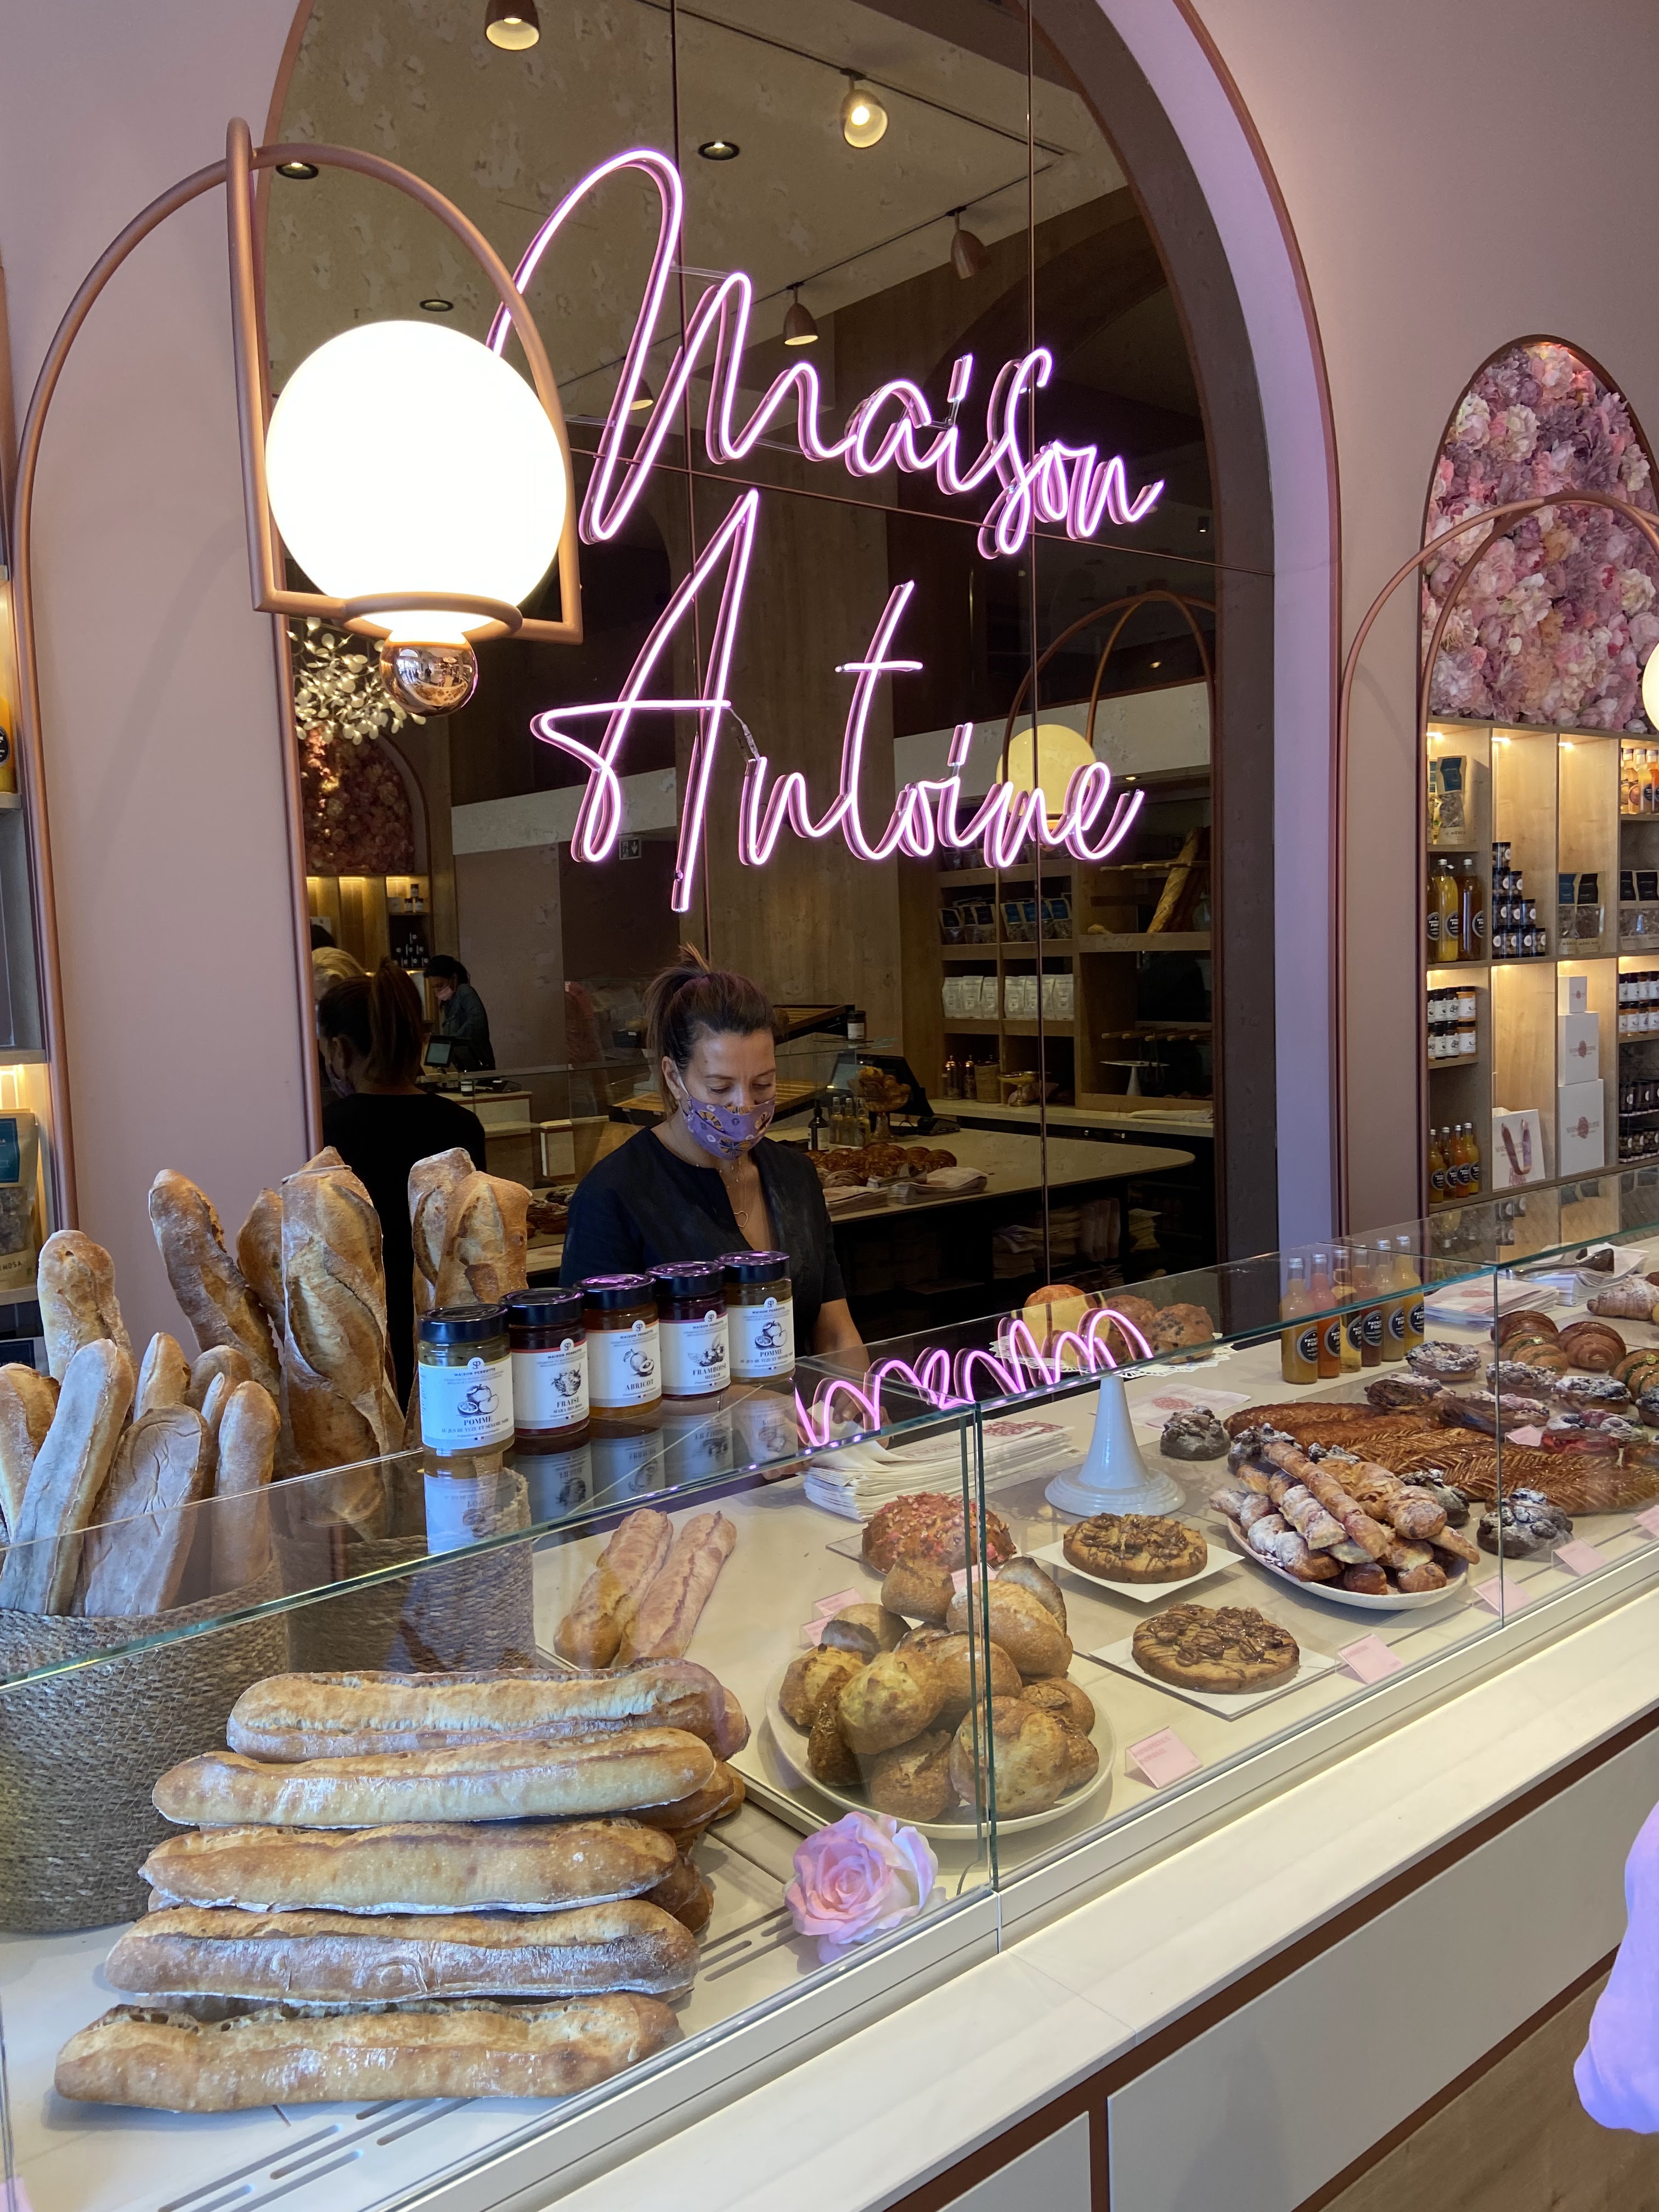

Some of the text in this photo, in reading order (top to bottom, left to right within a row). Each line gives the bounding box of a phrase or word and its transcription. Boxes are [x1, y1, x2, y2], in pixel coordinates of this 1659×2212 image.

[487, 148, 1164, 558] Maison
[531, 488, 1145, 912] Antoine
[0, 1261, 22, 1271] MOSA
[760, 1349, 782, 1357] POMME
[692, 1362, 727, 1376] FRAMBOISE
[625, 1379, 654, 1391] ABRICOT
[557, 1396, 580, 1408] FRAISE
[464, 1415, 493, 1426] POMME
